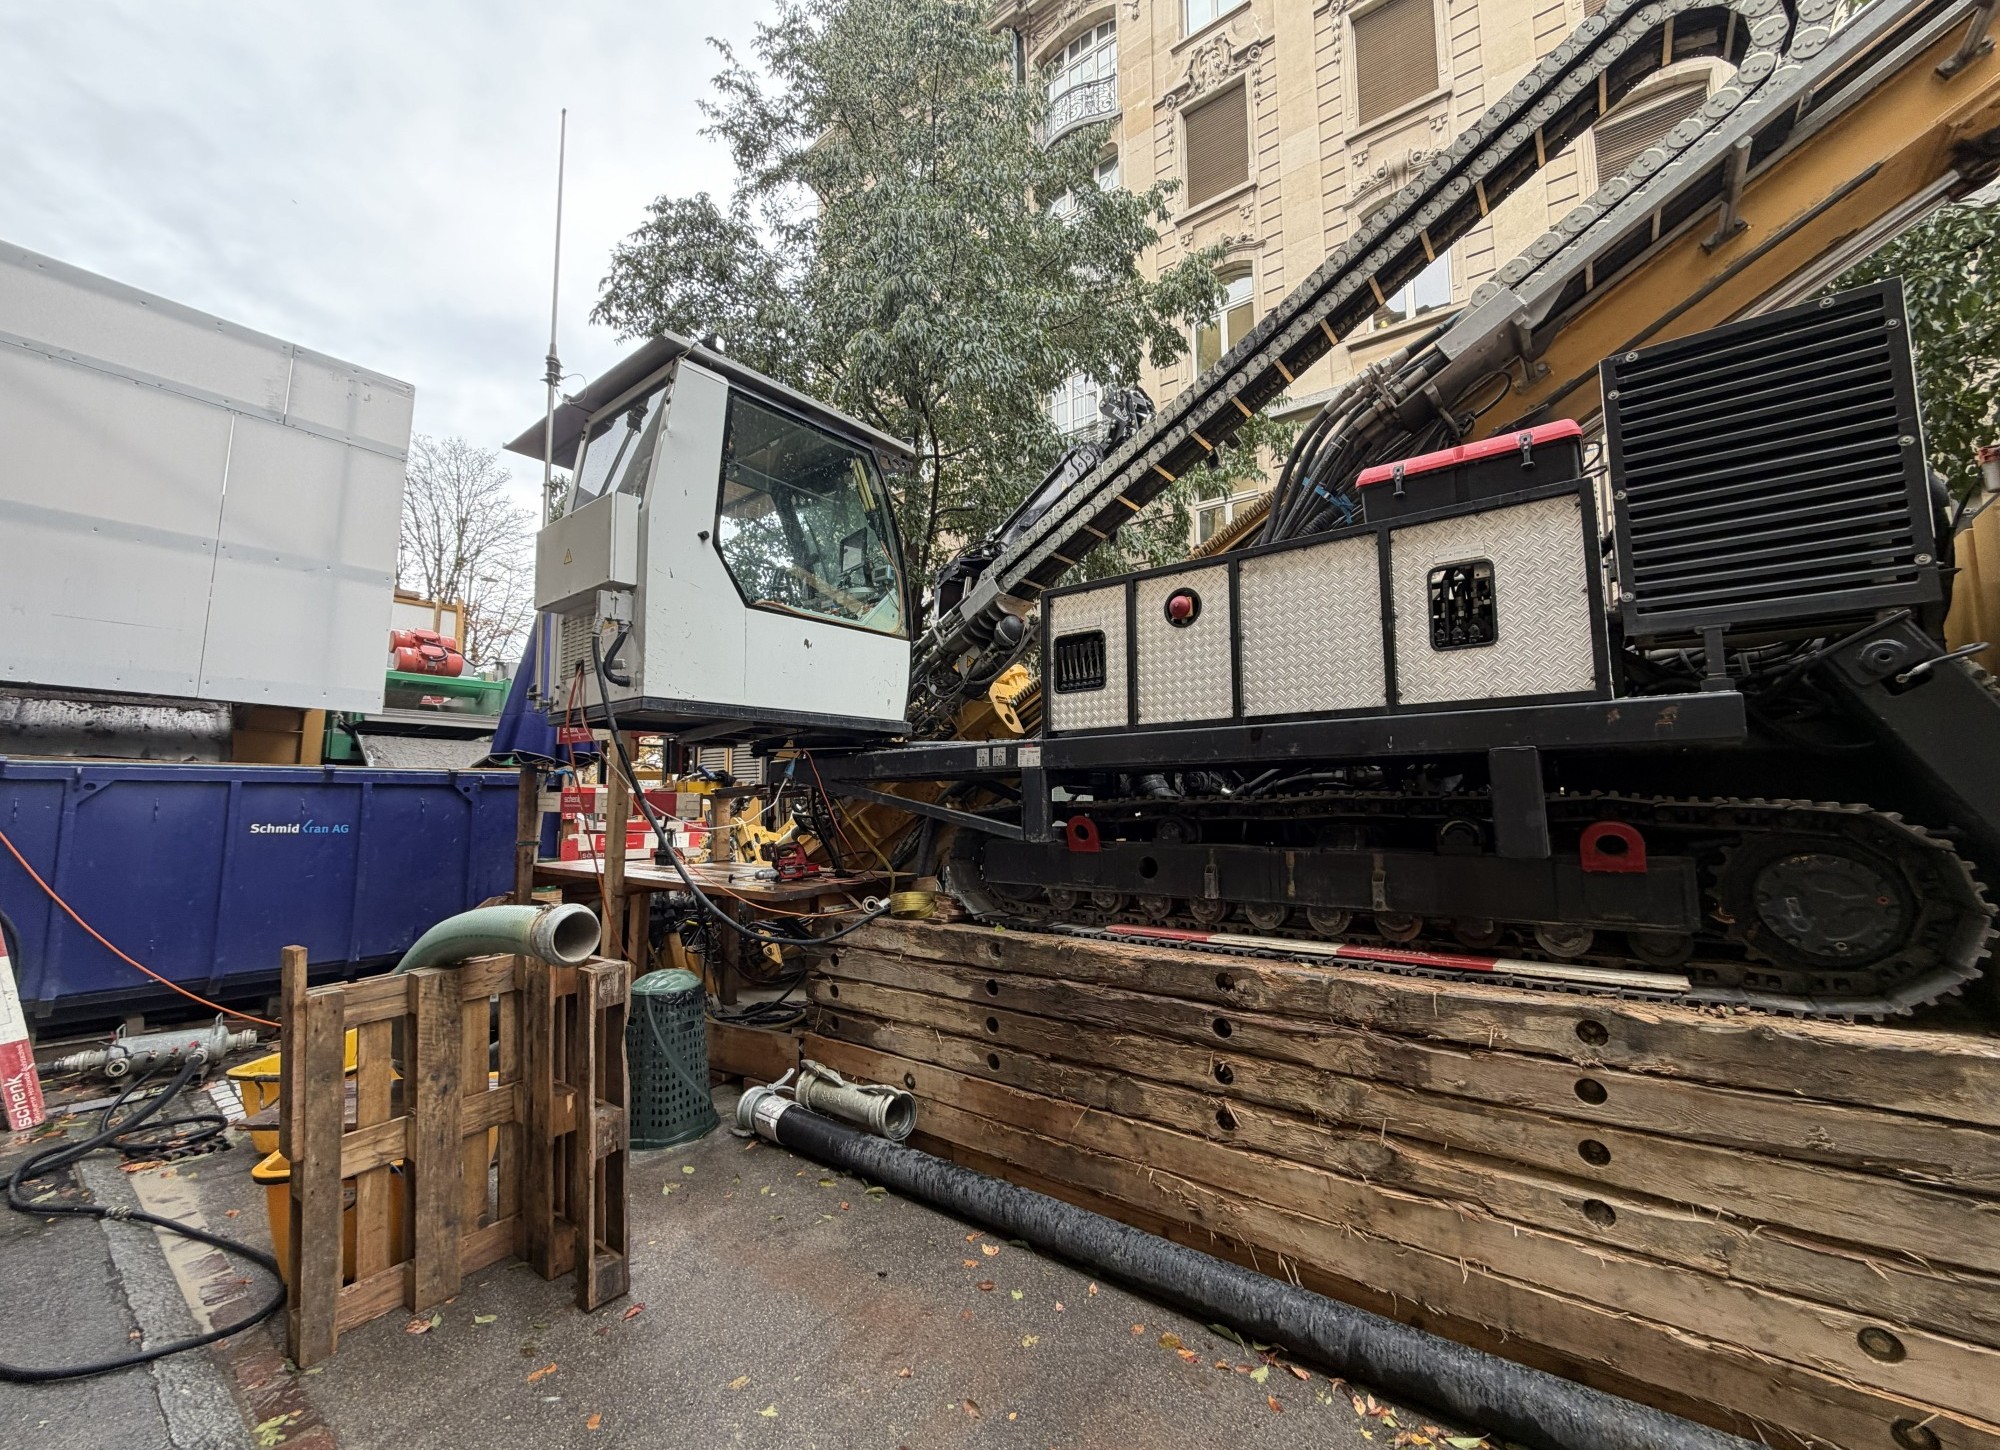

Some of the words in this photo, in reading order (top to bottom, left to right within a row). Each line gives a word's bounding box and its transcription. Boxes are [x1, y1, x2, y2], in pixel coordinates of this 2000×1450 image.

[249, 823, 300, 834] Schmid
[331, 824, 349, 834] AG
[4, 1063, 35, 1128] schenk
